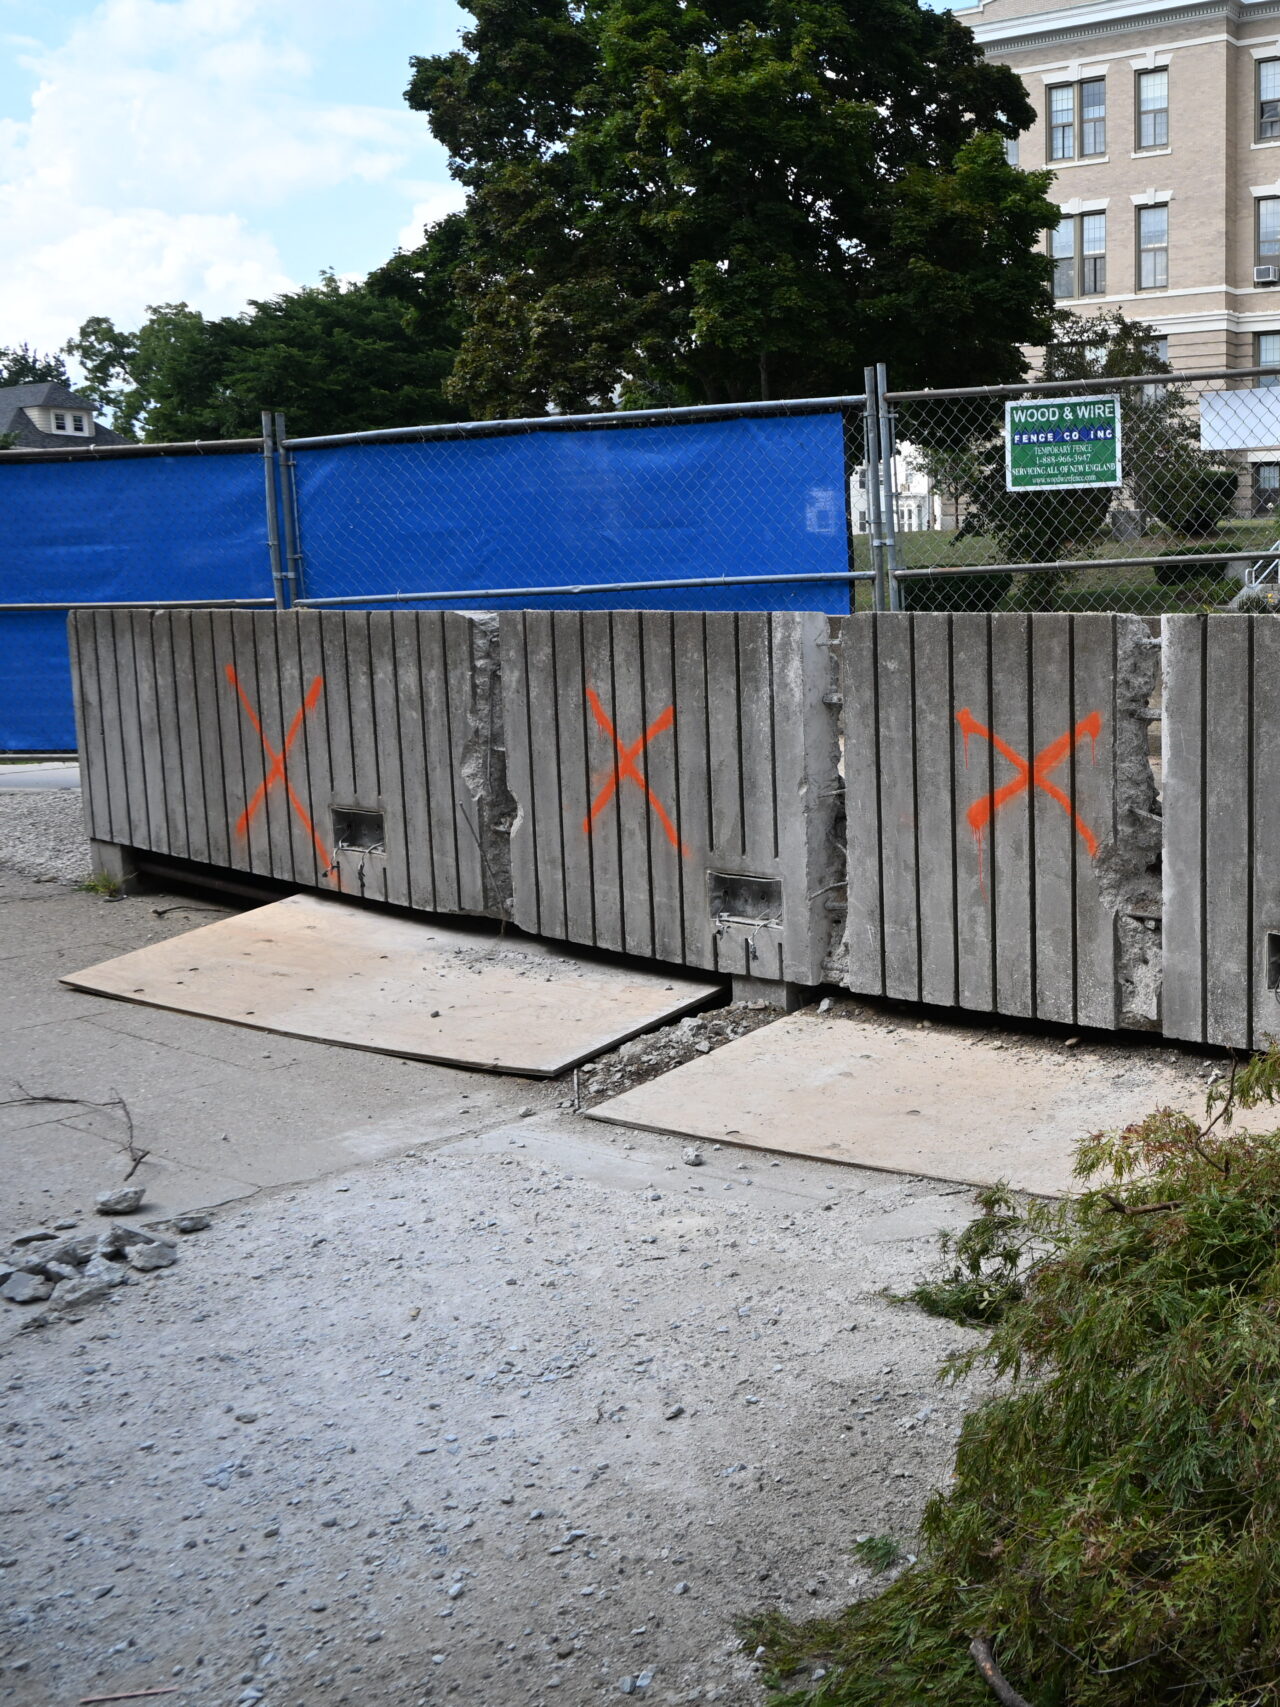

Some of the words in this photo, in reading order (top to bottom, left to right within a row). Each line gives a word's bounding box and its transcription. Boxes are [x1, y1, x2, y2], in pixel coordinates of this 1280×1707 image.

[1013, 408, 1059, 423] WOOD
[1063, 406, 1073, 420] &
[1076, 403, 1114, 419] WIRE
[1014, 432, 1054, 443] FENCE
[1063, 431, 1079, 440] CO
[1034, 445, 1071, 454] TEMPORARY
[1072, 444, 1092, 452] FENCE
[1036, 454, 1091, 464] 1-888-966-3947
[1012, 466, 1046, 476] SERVICING
[1047, 466, 1059, 474] ALL
[1060, 465, 1069, 474] OF
[1070, 464, 1084, 473] NEW
[1085, 462, 1116, 472] ENGLAND
